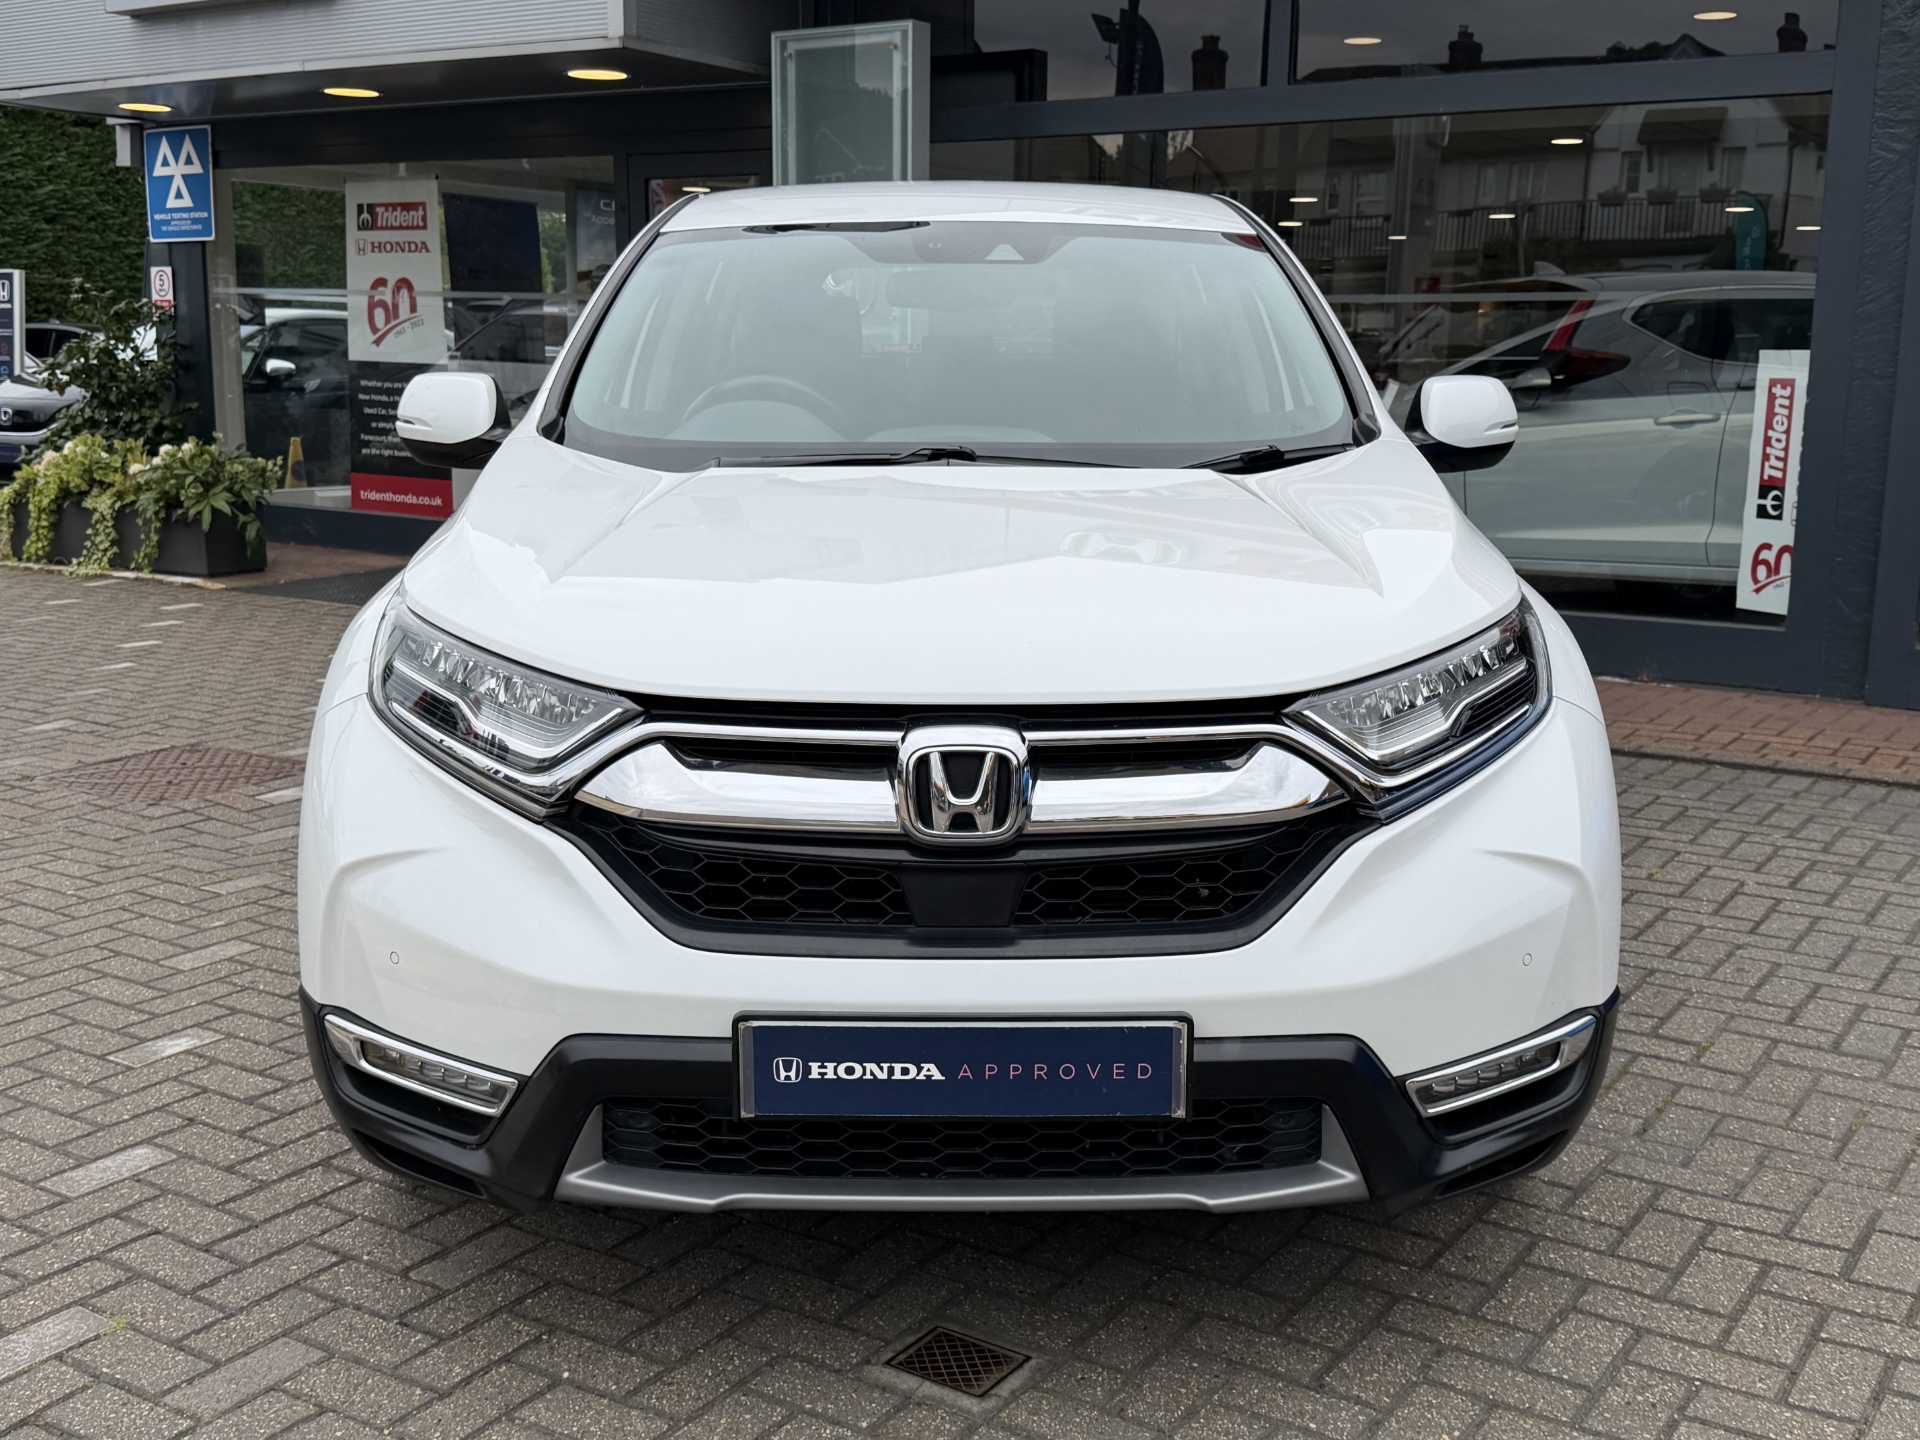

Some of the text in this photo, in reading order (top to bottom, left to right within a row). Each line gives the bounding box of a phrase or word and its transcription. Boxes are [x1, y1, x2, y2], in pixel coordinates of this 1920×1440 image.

[376, 205, 425, 228] Trident
[370, 240, 431, 254] HONDA
[1763, 384, 1791, 480] Trident
[360, 489, 442, 506] tridenthonda.co.uk
[808, 1062, 1153, 1081] HONDA APPROVED
